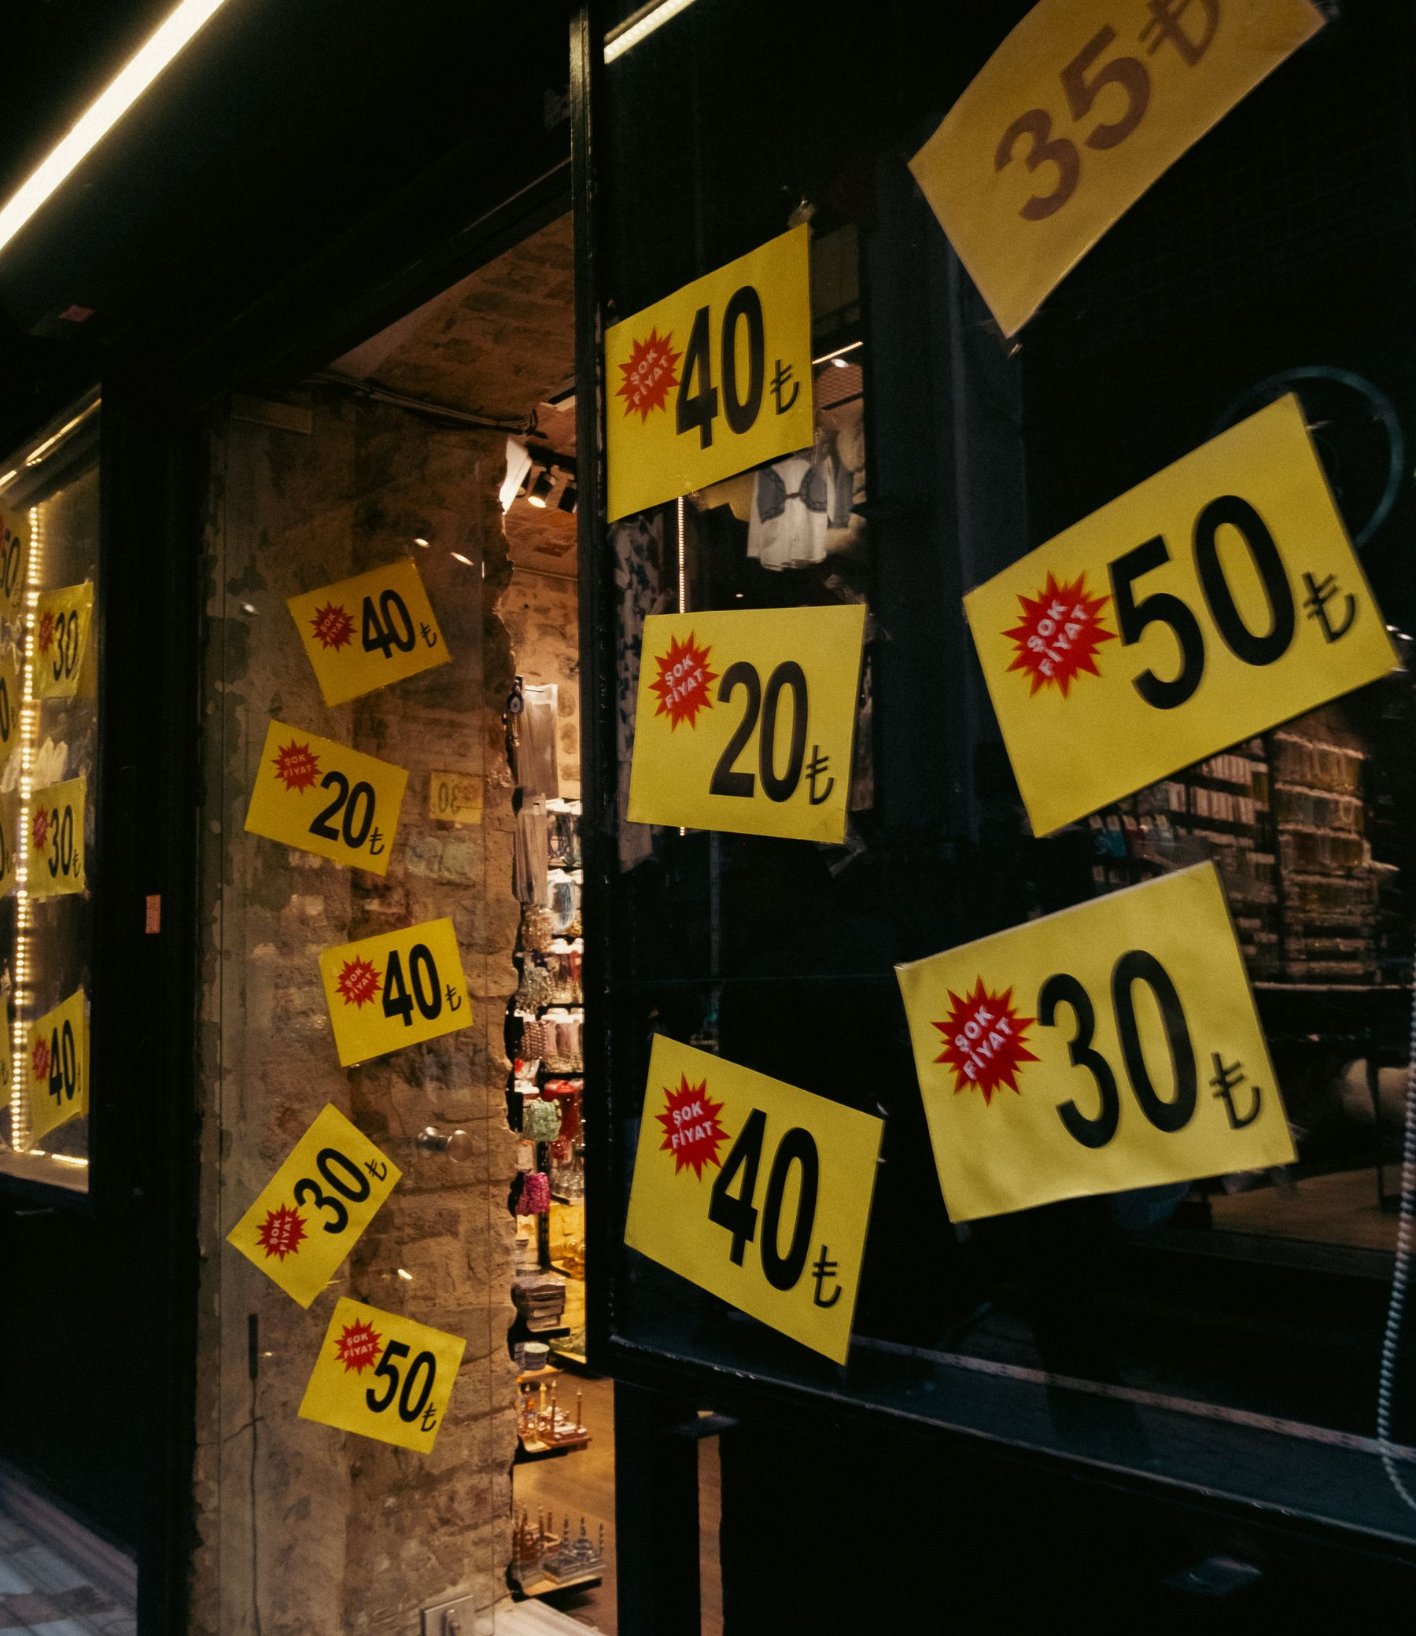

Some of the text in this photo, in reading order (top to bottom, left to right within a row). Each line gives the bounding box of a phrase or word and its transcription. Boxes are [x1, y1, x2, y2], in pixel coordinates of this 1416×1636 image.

[664, 653, 694, 689] ŞOK
[664, 667, 704, 710] FİYAT
[672, 1100, 705, 1127] ŞOK
[670, 1120, 714, 1149] FİYAT
